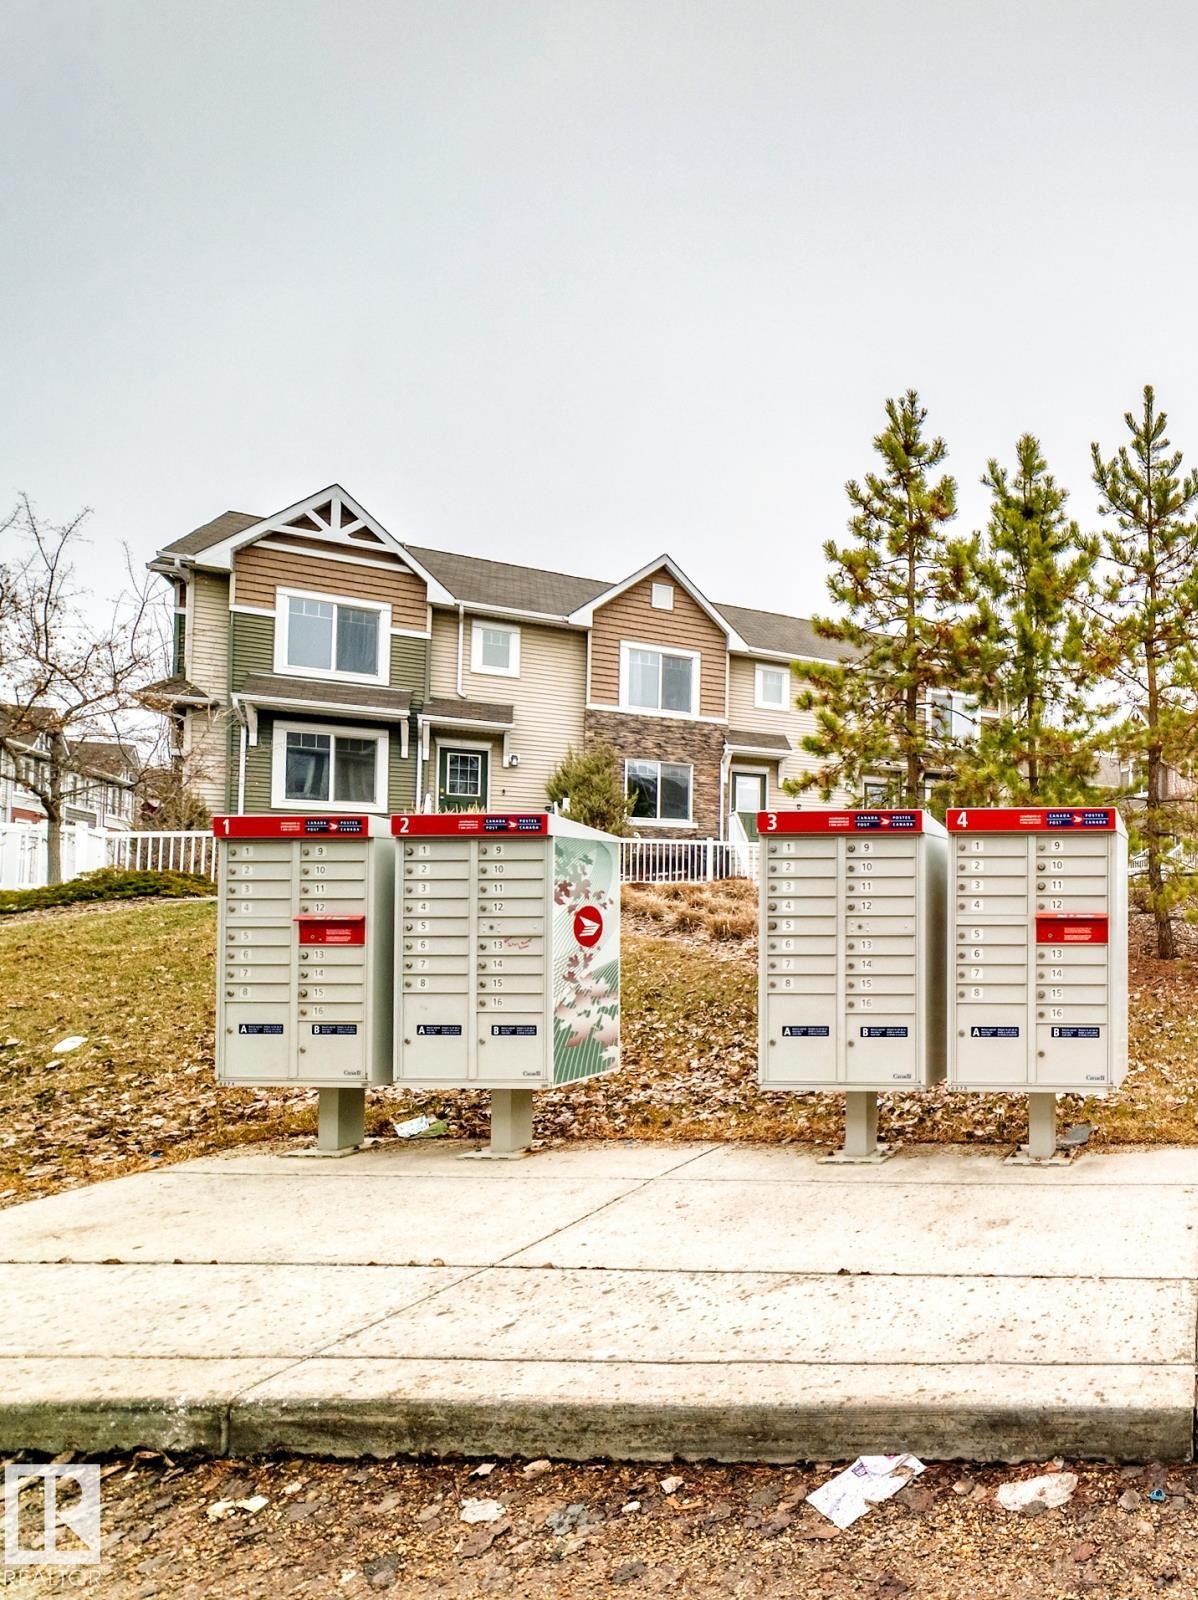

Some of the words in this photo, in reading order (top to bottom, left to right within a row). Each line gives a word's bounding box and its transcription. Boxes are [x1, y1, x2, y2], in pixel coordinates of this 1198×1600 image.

[767, 814, 777, 830] 3
[957, 811, 968, 828] 4
[223, 819, 229, 834] 1
[400, 817, 409, 833] 2
[864, 843, 870, 852] 9
[1054, 841, 1060, 850] 9
[318, 847, 323, 855] 9
[496, 846, 501, 854] 9
[421, 865, 427, 873] 2
[494, 865, 504, 873] 10
[786, 862, 791, 871] 2
[862, 862, 872, 871] 10
[975, 861, 980, 870] 2
[1053, 861, 1062, 869] 10
[316, 866, 326, 874] 10
[315, 884, 325, 892] 11
[421, 883, 427, 892] 3
[494, 884, 503, 892] 11
[786, 881, 791, 890] 3
[862, 882, 871, 890] 11
[975, 880, 980, 889] 3
[1052, 880, 1062, 889] 11
[316, 903, 325, 911] 12
[421, 902, 426, 911] 4
[494, 903, 503, 911] 12
[785, 901, 791, 909] 4
[862, 902, 872, 910] 12
[974, 900, 980, 908] 4
[1052, 900, 1062, 908] 12
[421, 921, 426, 930] 5
[785, 920, 791, 929] 5
[974, 929, 980, 938] 5
[420, 940, 426, 949] 6
[494, 941, 503, 949] 13
[785, 940, 791, 948] 6
[862, 940, 871, 948] 13
[315, 950, 324, 959] 13
[974, 949, 980, 958] 6
[1052, 950, 1062, 958] 13
[420, 959, 426, 968] 7
[493, 960, 502, 968] 14
[785, 959, 791, 968] 7
[862, 960, 872, 968] 14
[243, 968, 248, 977] 7
[315, 969, 324, 977] 14
[974, 968, 980, 976] 7
[1052, 969, 1062, 977] 14
[420, 979, 426, 987] 8
[493, 979, 503, 987] 15
[785, 979, 791, 987] 8
[862, 979, 871, 988] 15
[242, 987, 248, 996] 8
[314, 988, 324, 996] 15
[974, 988, 980, 996] 8
[1052, 988, 1061, 996] 15
[493, 998, 502, 1006] 16
[862, 998, 871, 1007] 16
[314, 1006, 323, 1015] 16
[1052, 1008, 1062, 1017] 16
[240, 1025, 247, 1033] A
[314, 1025, 320, 1034] B
[418, 1026, 425, 1034] A
[493, 1025, 500, 1034] B
[784, 1027, 791, 1036] A
[862, 1028, 869, 1036] B
[973, 1028, 980, 1036] A
[1053, 1028, 1060, 1037] B
